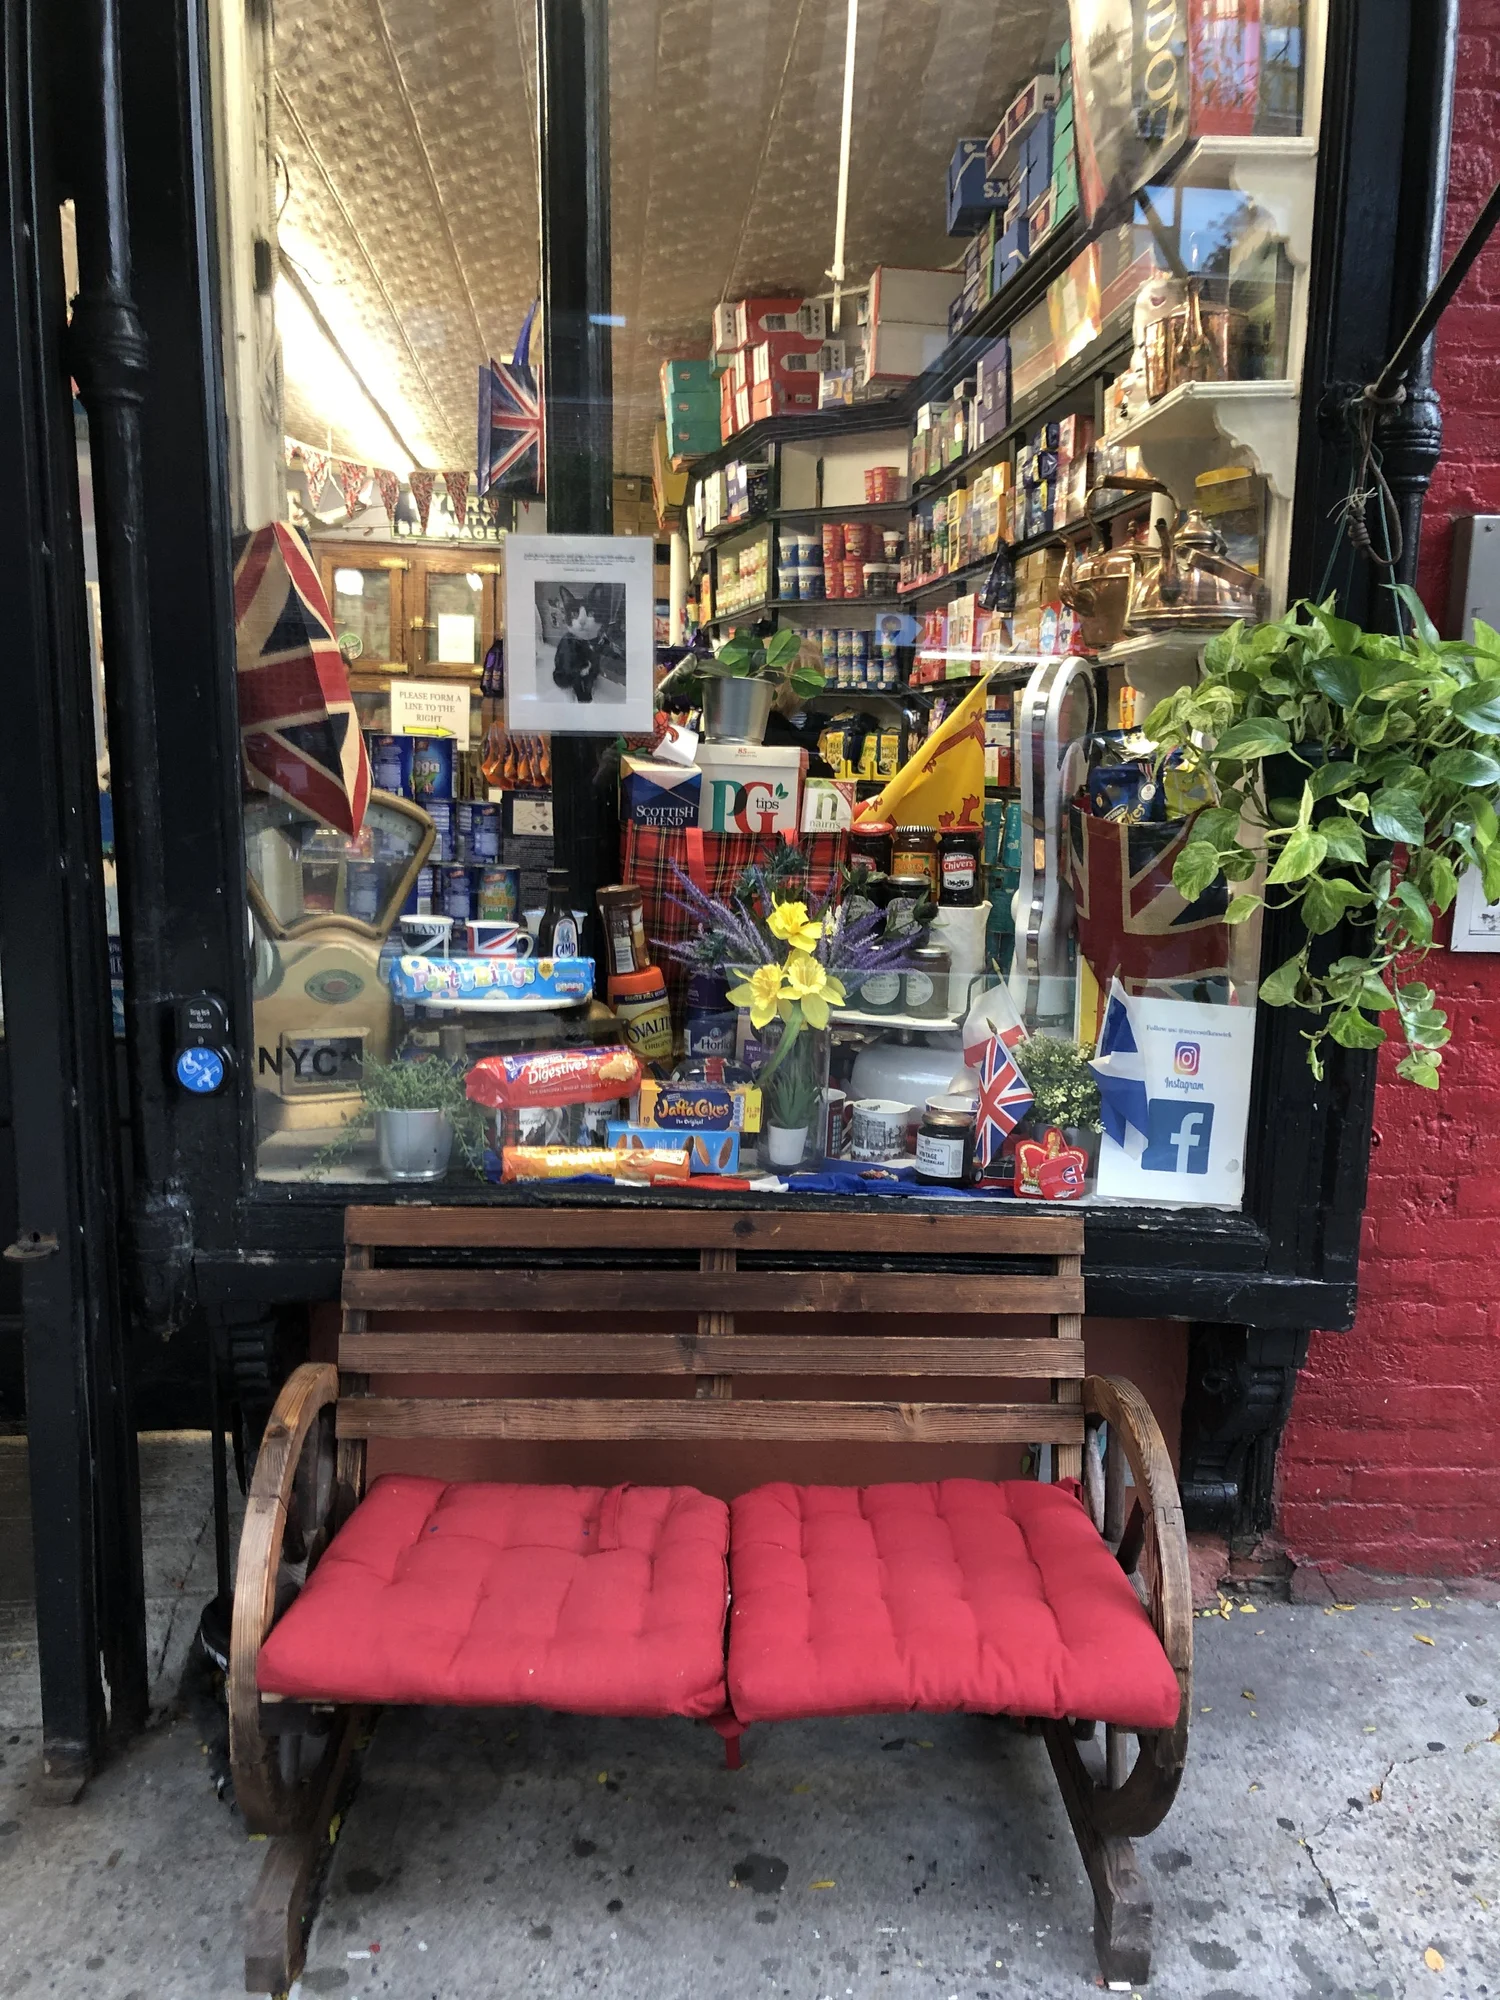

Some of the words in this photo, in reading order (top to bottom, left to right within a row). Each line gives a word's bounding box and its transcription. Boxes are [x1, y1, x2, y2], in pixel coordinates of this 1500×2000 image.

[399, 691, 428, 700] PLEASE
[430, 693, 454, 702] FORM
[404, 702, 424, 711] LINE
[425, 704, 437, 712] TO
[437, 704, 456, 713] THE
[416, 713, 443, 723] RIGHT
[636, 805, 695, 818] SCOTTISH
[709, 780, 779, 833] PG
[755, 798, 780, 812] tips
[645, 816, 684, 827] BLEND
[943, 860, 974, 871] Chivers
[554, 944, 576, 957] CAMP
[413, 968, 474, 993] Party
[474, 965, 536, 988] Rings
[1146, 1024, 1167, 1032] Follow
[528, 1059, 588, 1085] Digestives
[1164, 1076, 1205, 1094] Instagram
[657, 1098, 694, 1119] Jaffa
[694, 1098, 729, 1120] Cakes
